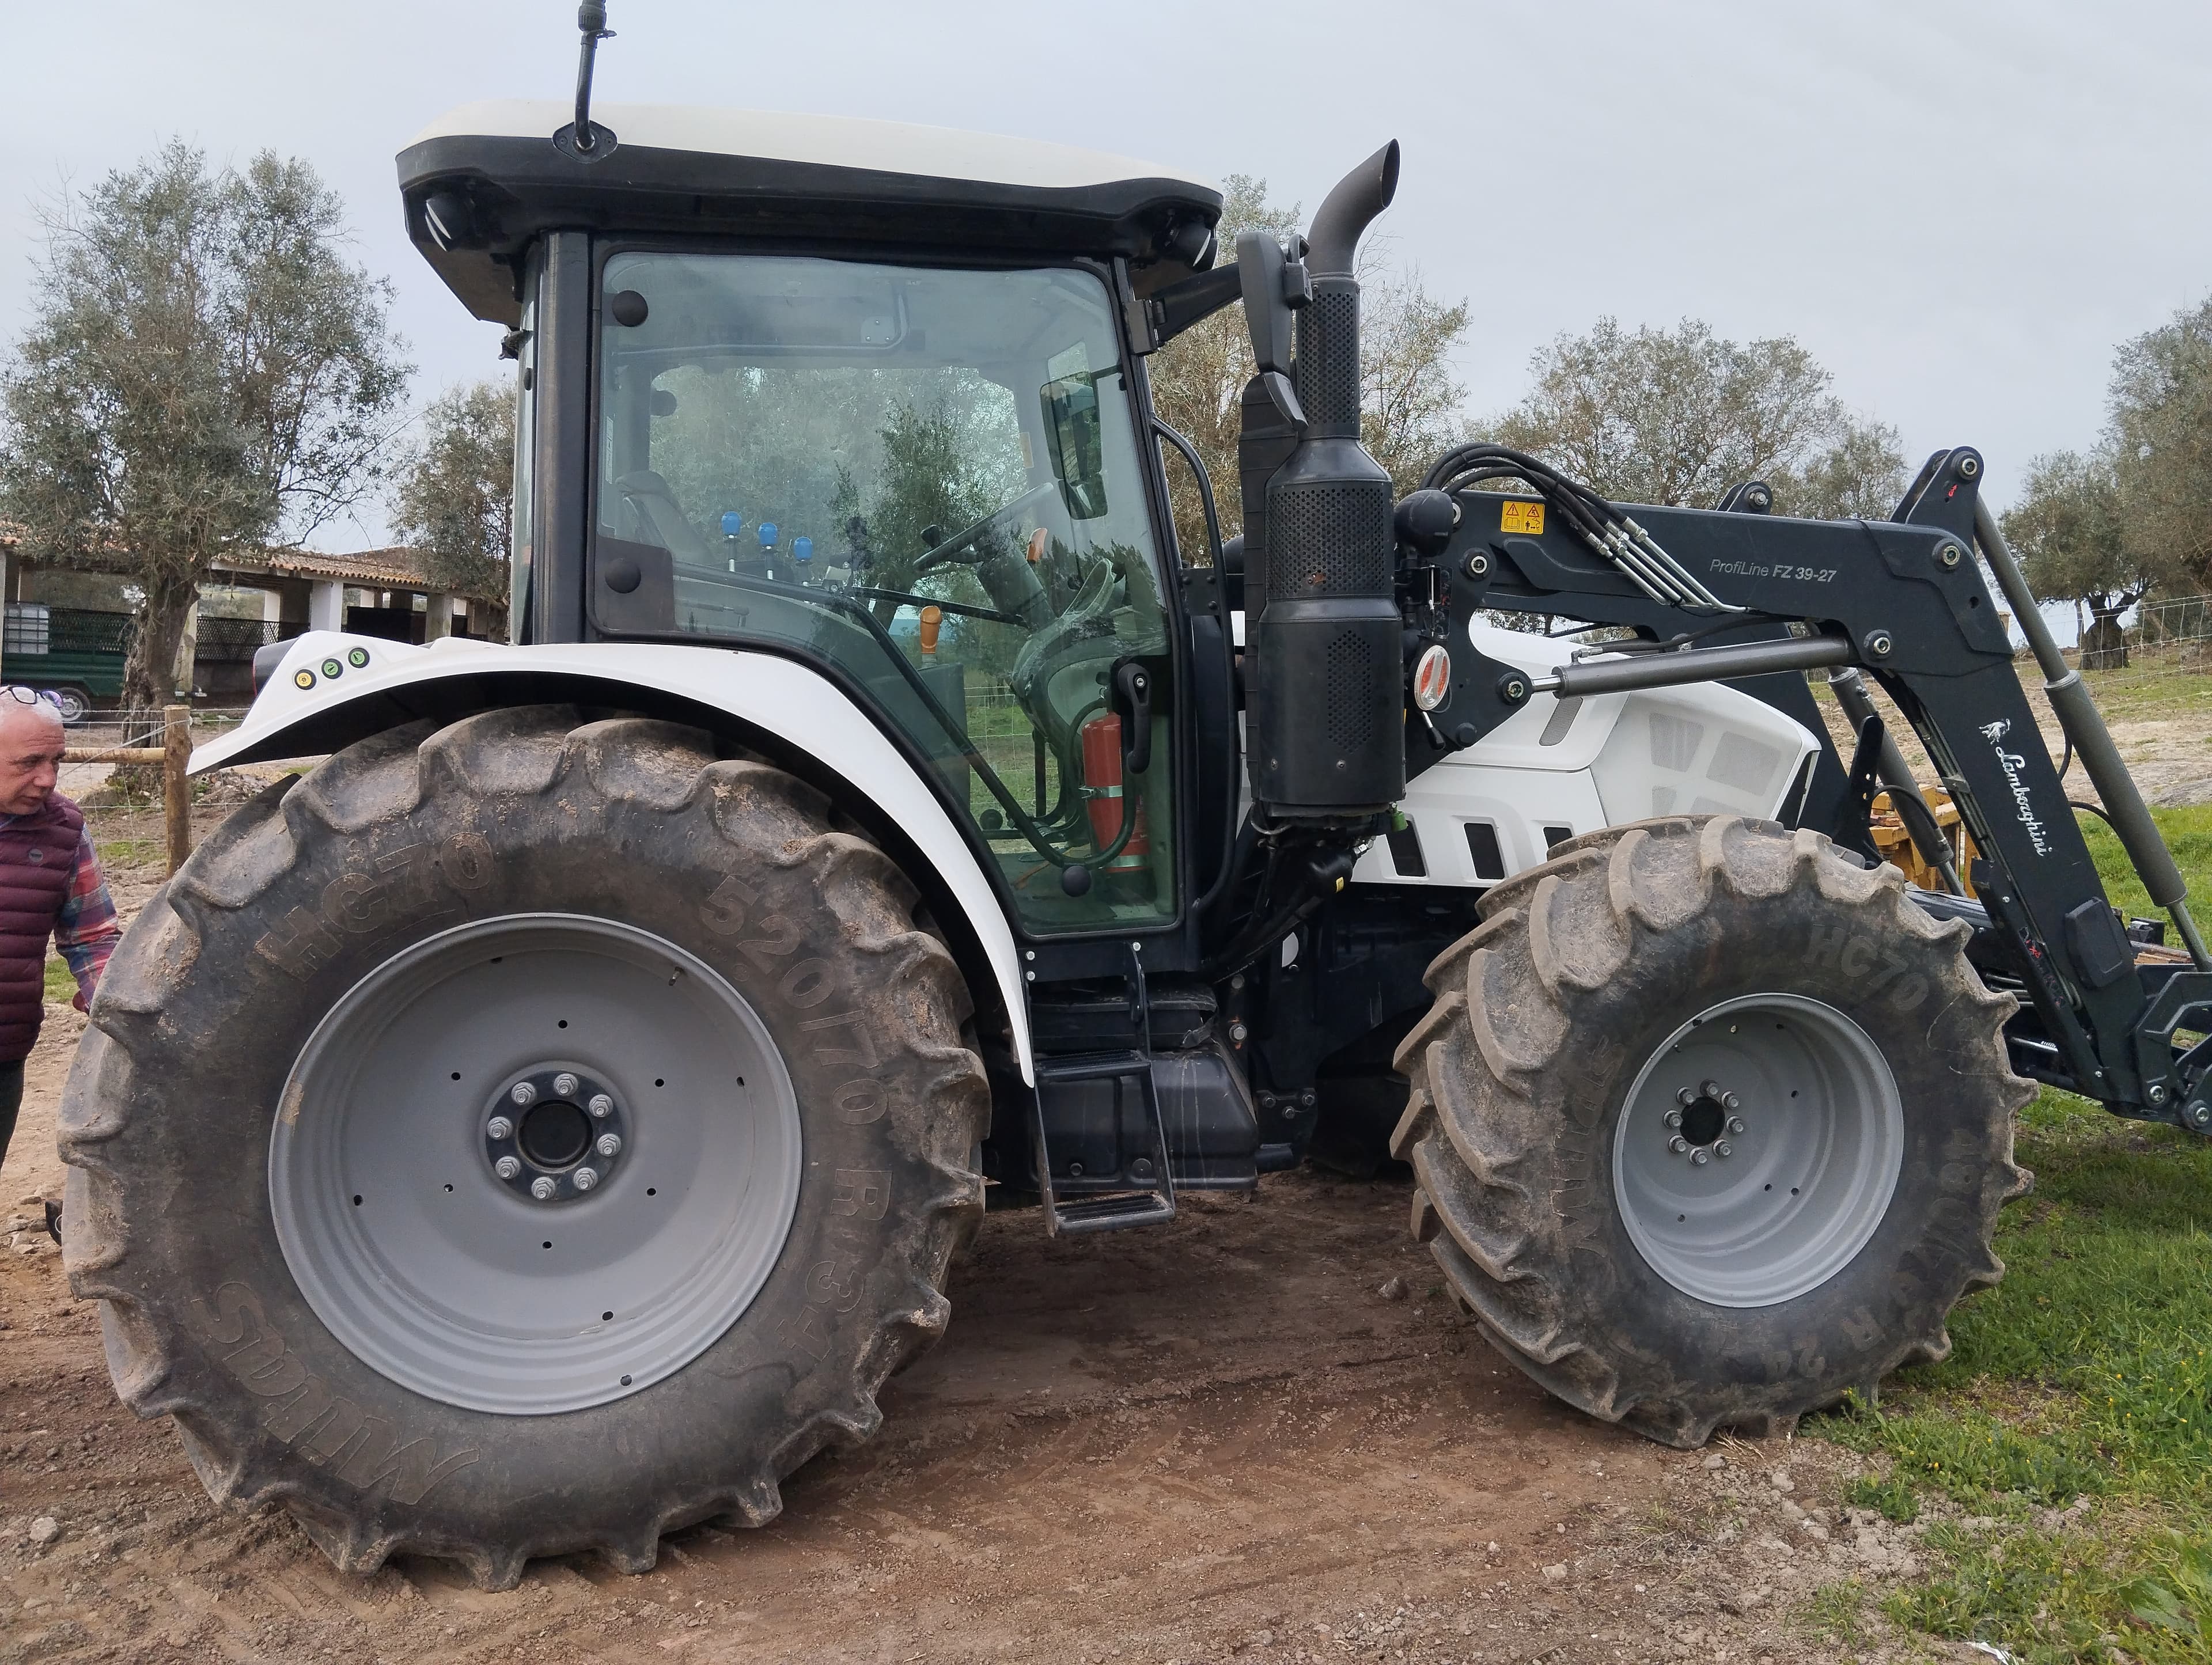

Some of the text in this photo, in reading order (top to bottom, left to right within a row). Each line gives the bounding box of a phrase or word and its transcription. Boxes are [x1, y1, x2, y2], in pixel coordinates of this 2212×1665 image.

[1710, 559, 1838, 583] ProfiLine FZ 39-27
[1995, 746, 2052, 857] Lamborghini
[700, 874, 889, 1126] 520/70
[830, 1169, 893, 1222] R
